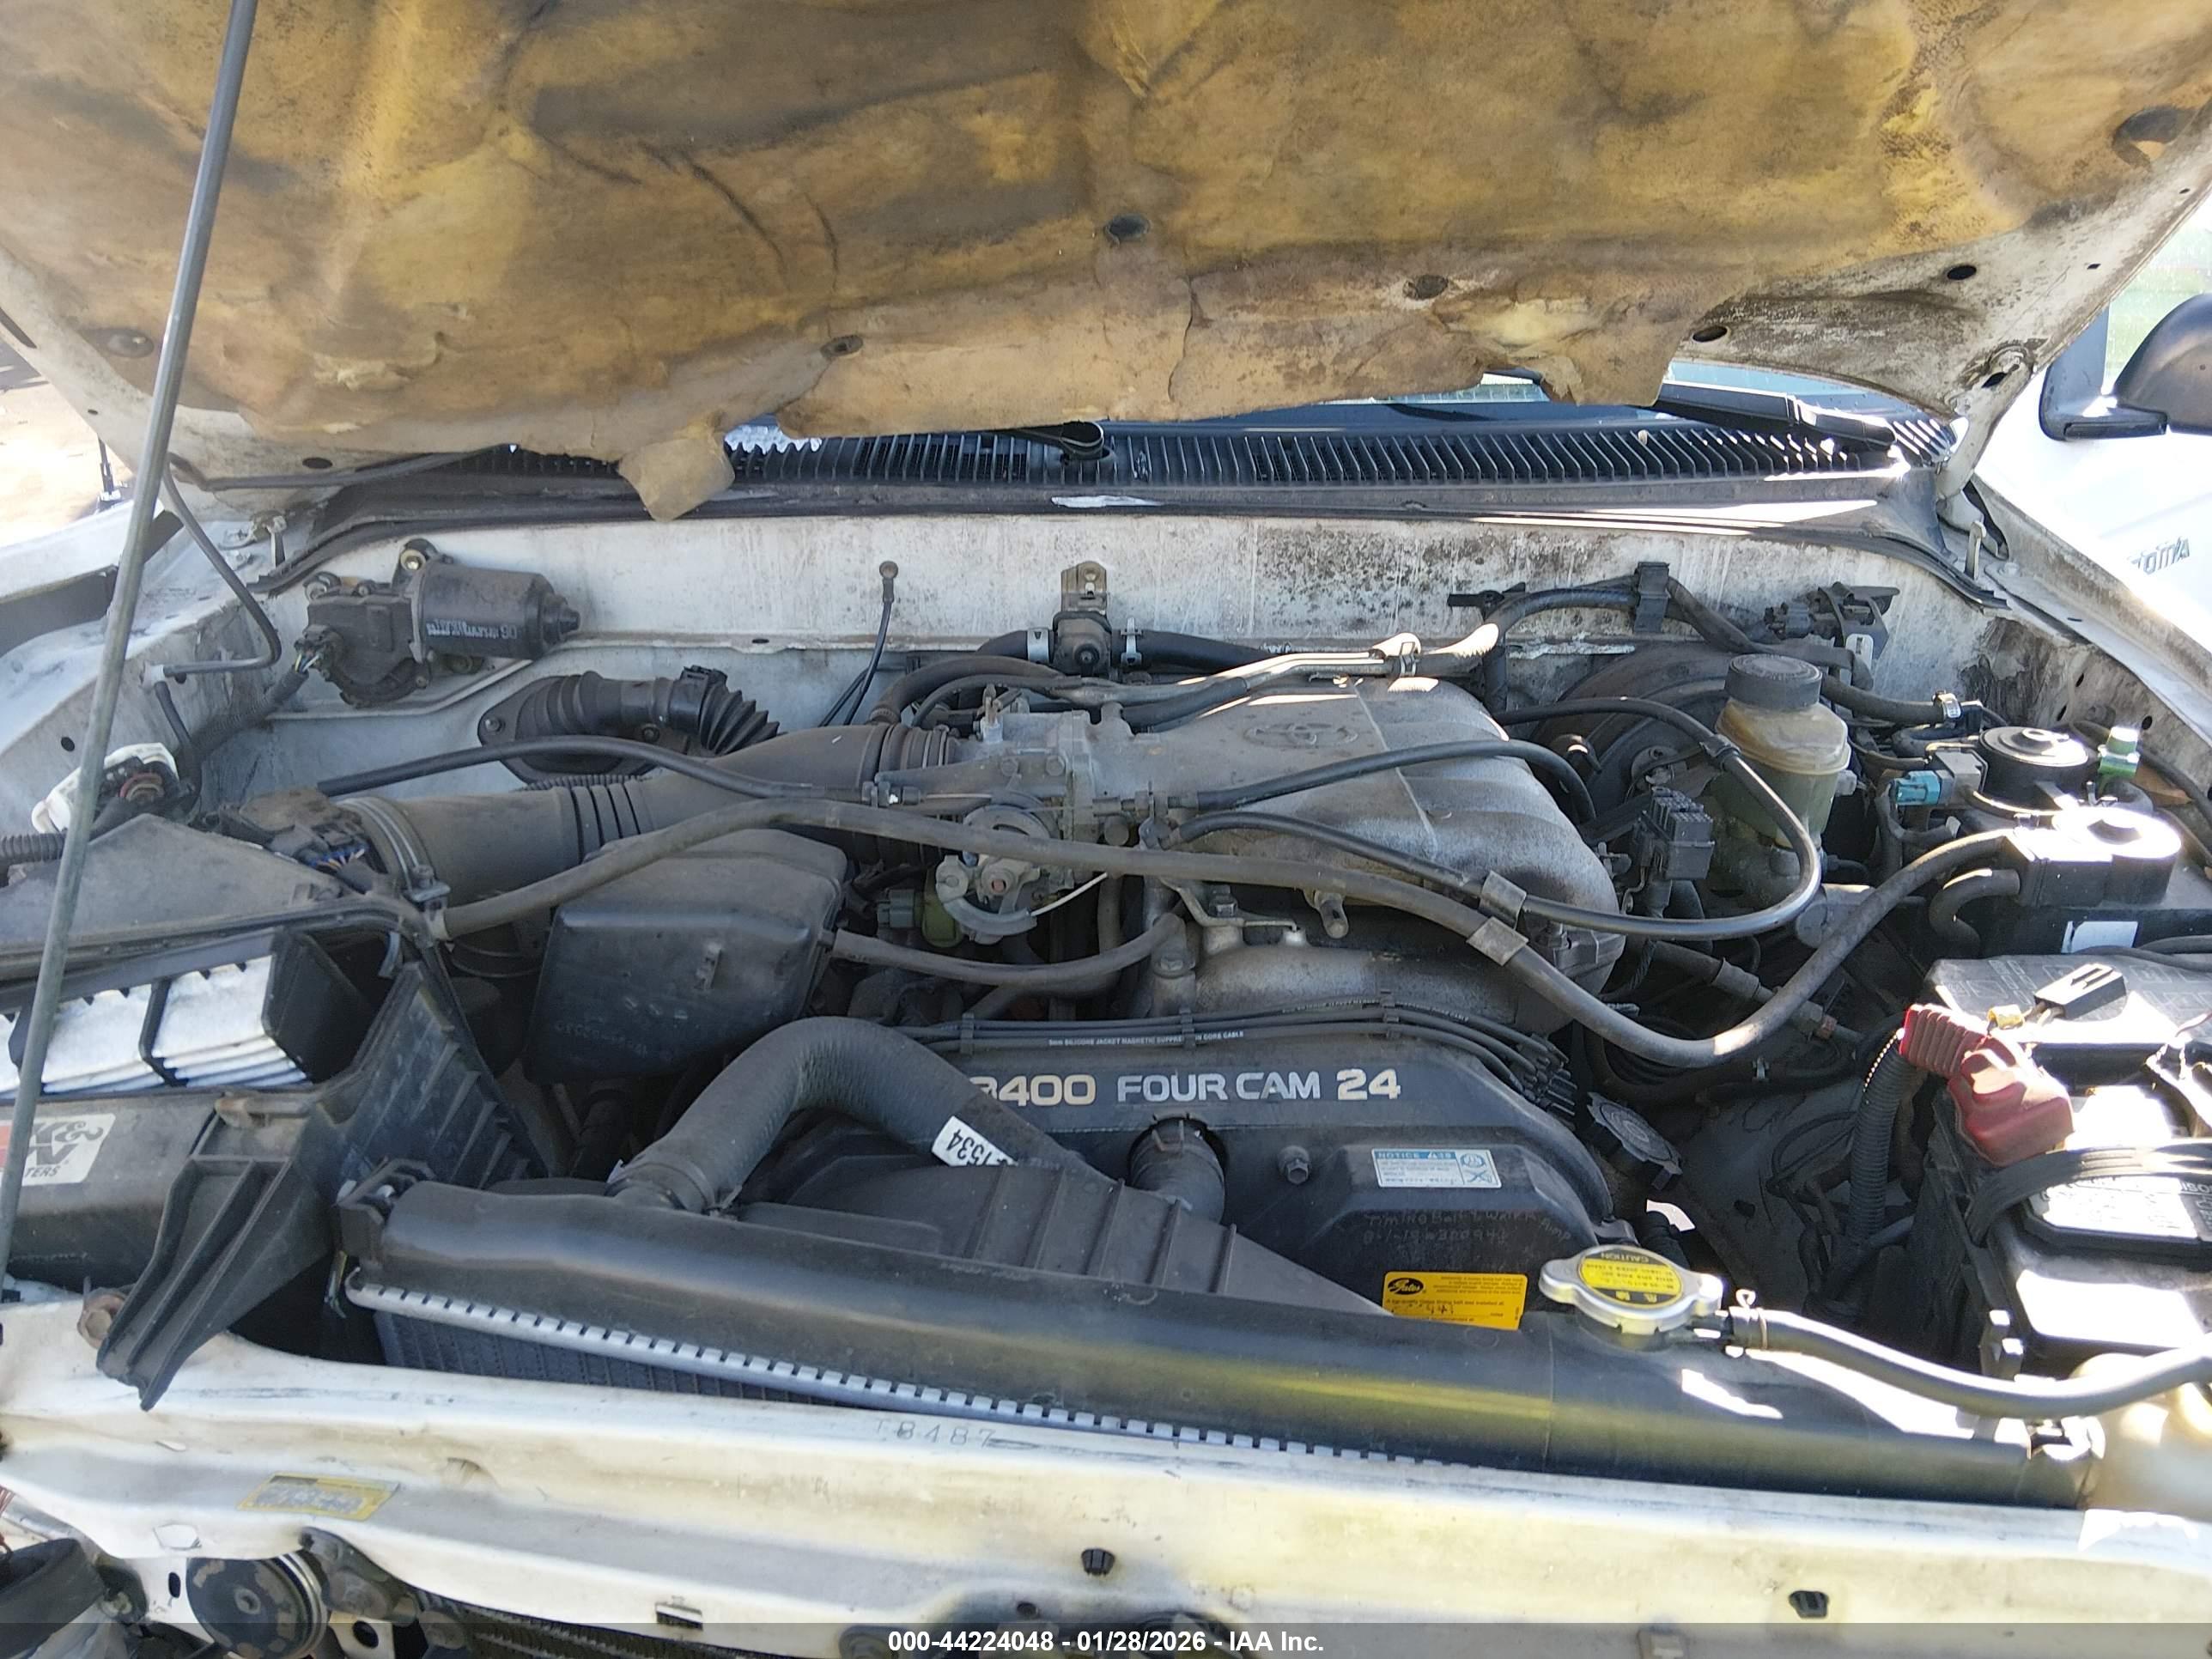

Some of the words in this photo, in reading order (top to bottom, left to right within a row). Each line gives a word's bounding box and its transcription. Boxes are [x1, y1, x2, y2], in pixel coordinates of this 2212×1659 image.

[1117, 1073, 1227, 1103] FOUR
[1235, 1071, 1322, 1101] CAM
[1336, 1068, 1402, 1100] 24
[1378, 1151, 1420, 1159] NOTICE
[24, 1164, 61, 1178] TERS
[1600, 1252, 1650, 1263] CAUTION
[1388, 1279, 1421, 1293] Gates
